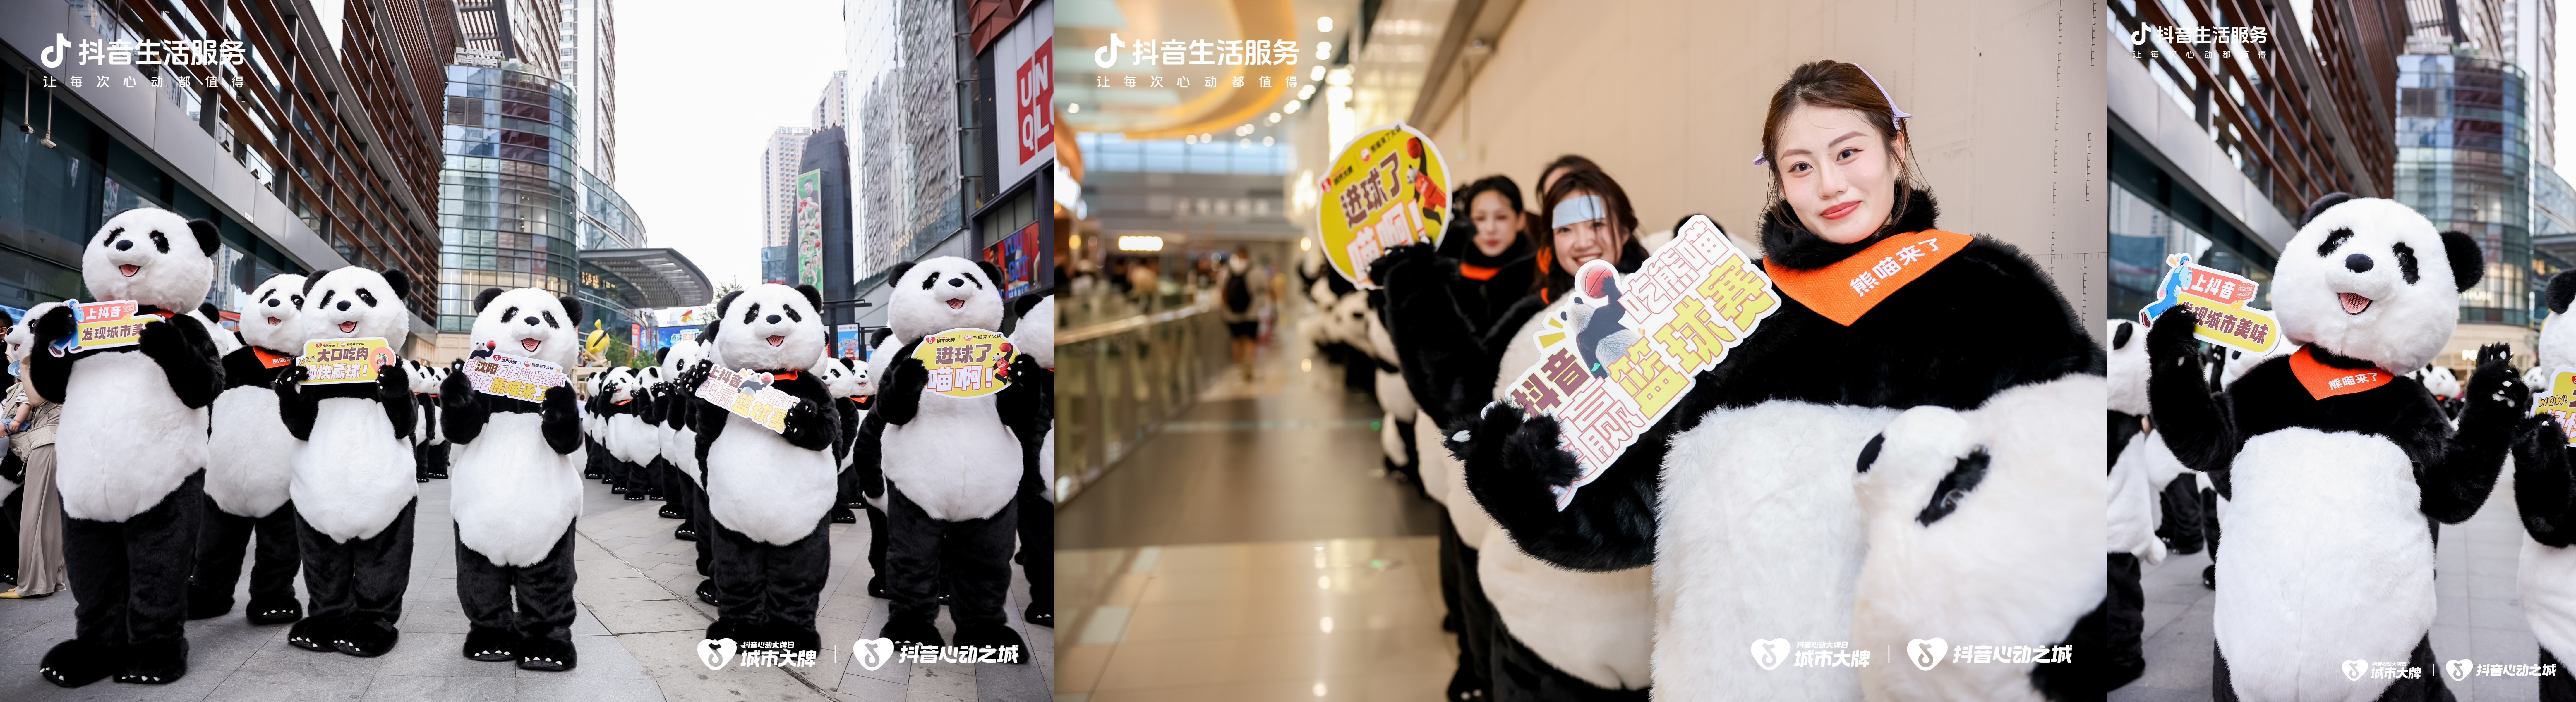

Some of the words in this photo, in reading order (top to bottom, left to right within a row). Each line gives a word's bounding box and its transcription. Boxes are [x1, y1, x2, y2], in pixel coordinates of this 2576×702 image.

[1340, 151, 1400, 230] 进球了
[1003, 230, 1023, 257] YOU
[1009, 255, 1028, 282] GOT
[1617, 221, 1729, 324] 吃熊喵
[1849, 237, 1940, 297] 熊喵来了
[2191, 274, 2236, 300] 上抖音
[85, 305, 121, 320] 上抖音
[82, 323, 146, 341] 发现城市美
[299, 355, 316, 365] WOW!
[317, 347, 369, 362] 大口吃肉
[936, 344, 992, 365] 进球了
[465, 359, 565, 387] 到沈阳看男篮世界杯
[708, 366, 743, 388] 上抖音
[2328, 373, 2378, 390] 熊喵来了
[2539, 395, 2568, 407] WOW!
